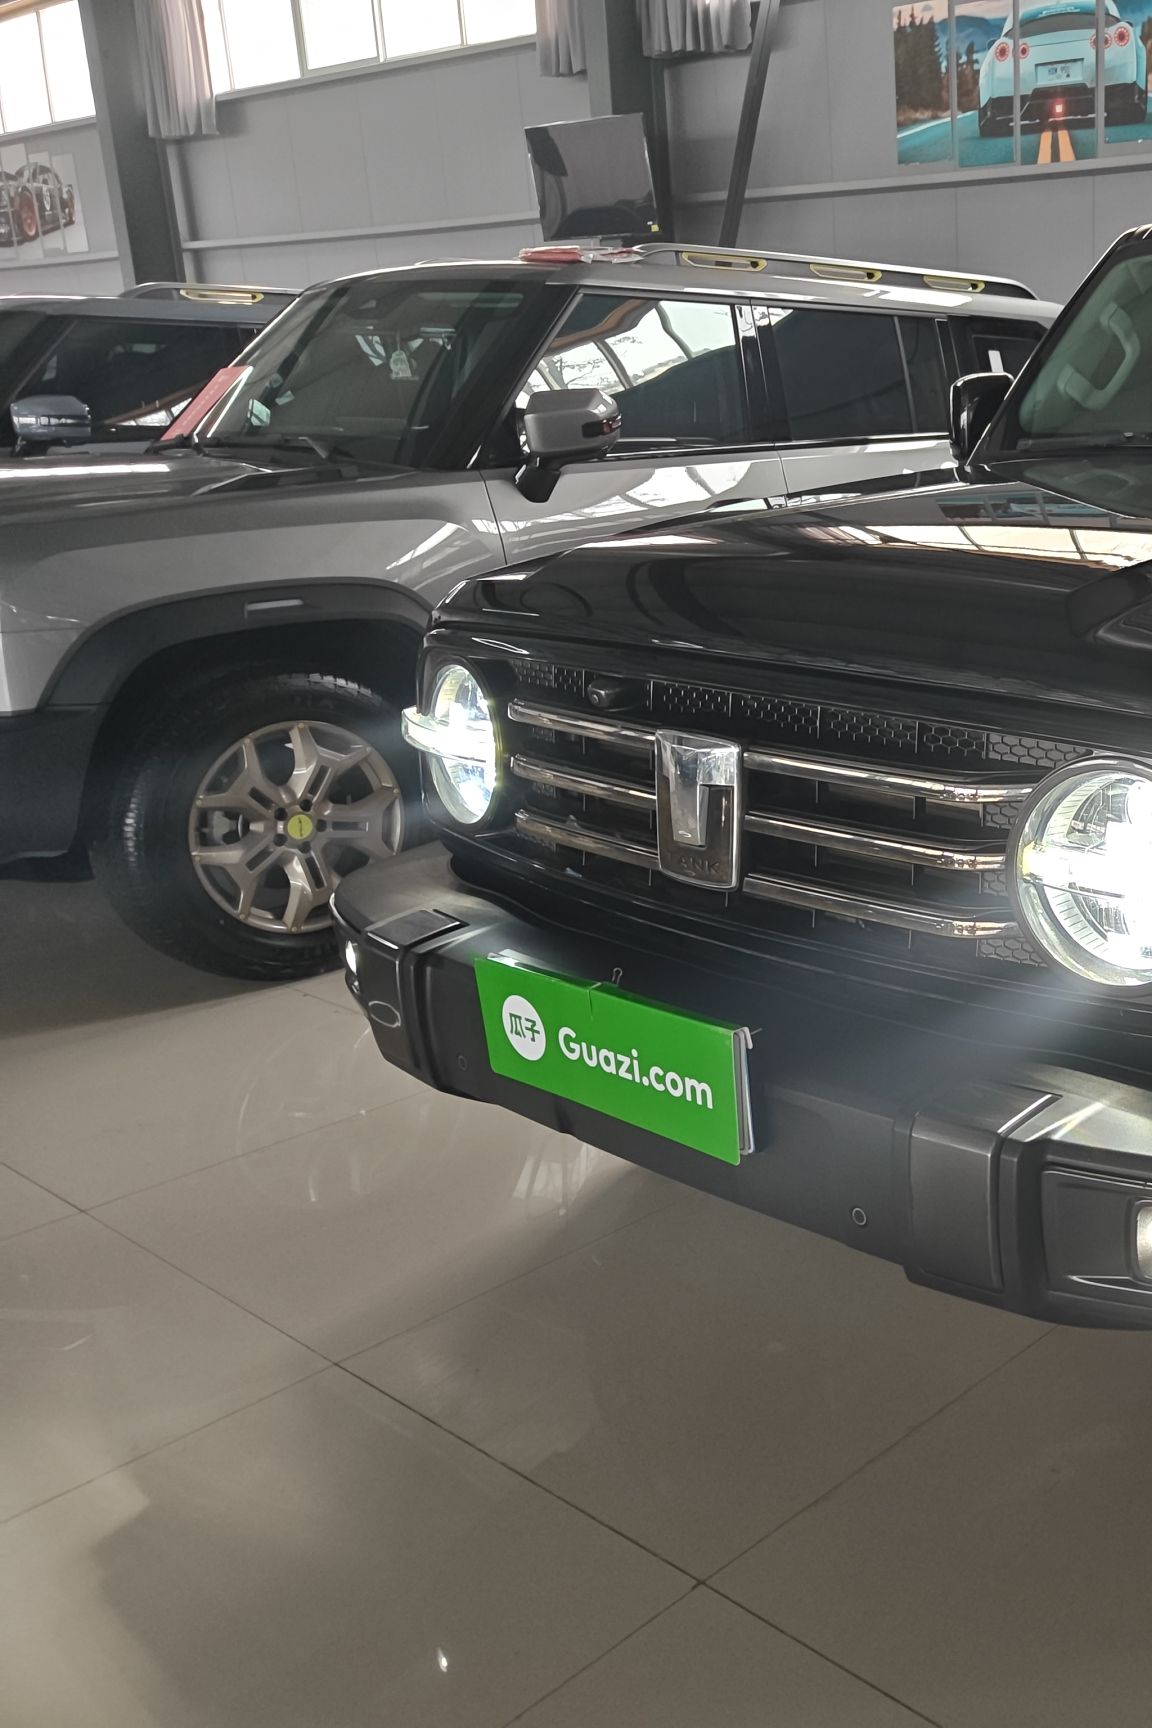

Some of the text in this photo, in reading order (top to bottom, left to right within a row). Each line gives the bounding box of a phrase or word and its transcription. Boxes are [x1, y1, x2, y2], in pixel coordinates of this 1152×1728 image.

[678, 855, 720, 875] ANK
[508, 1012, 541, 1042] 瓜子
[558, 1026, 713, 1109] Guazi.com
